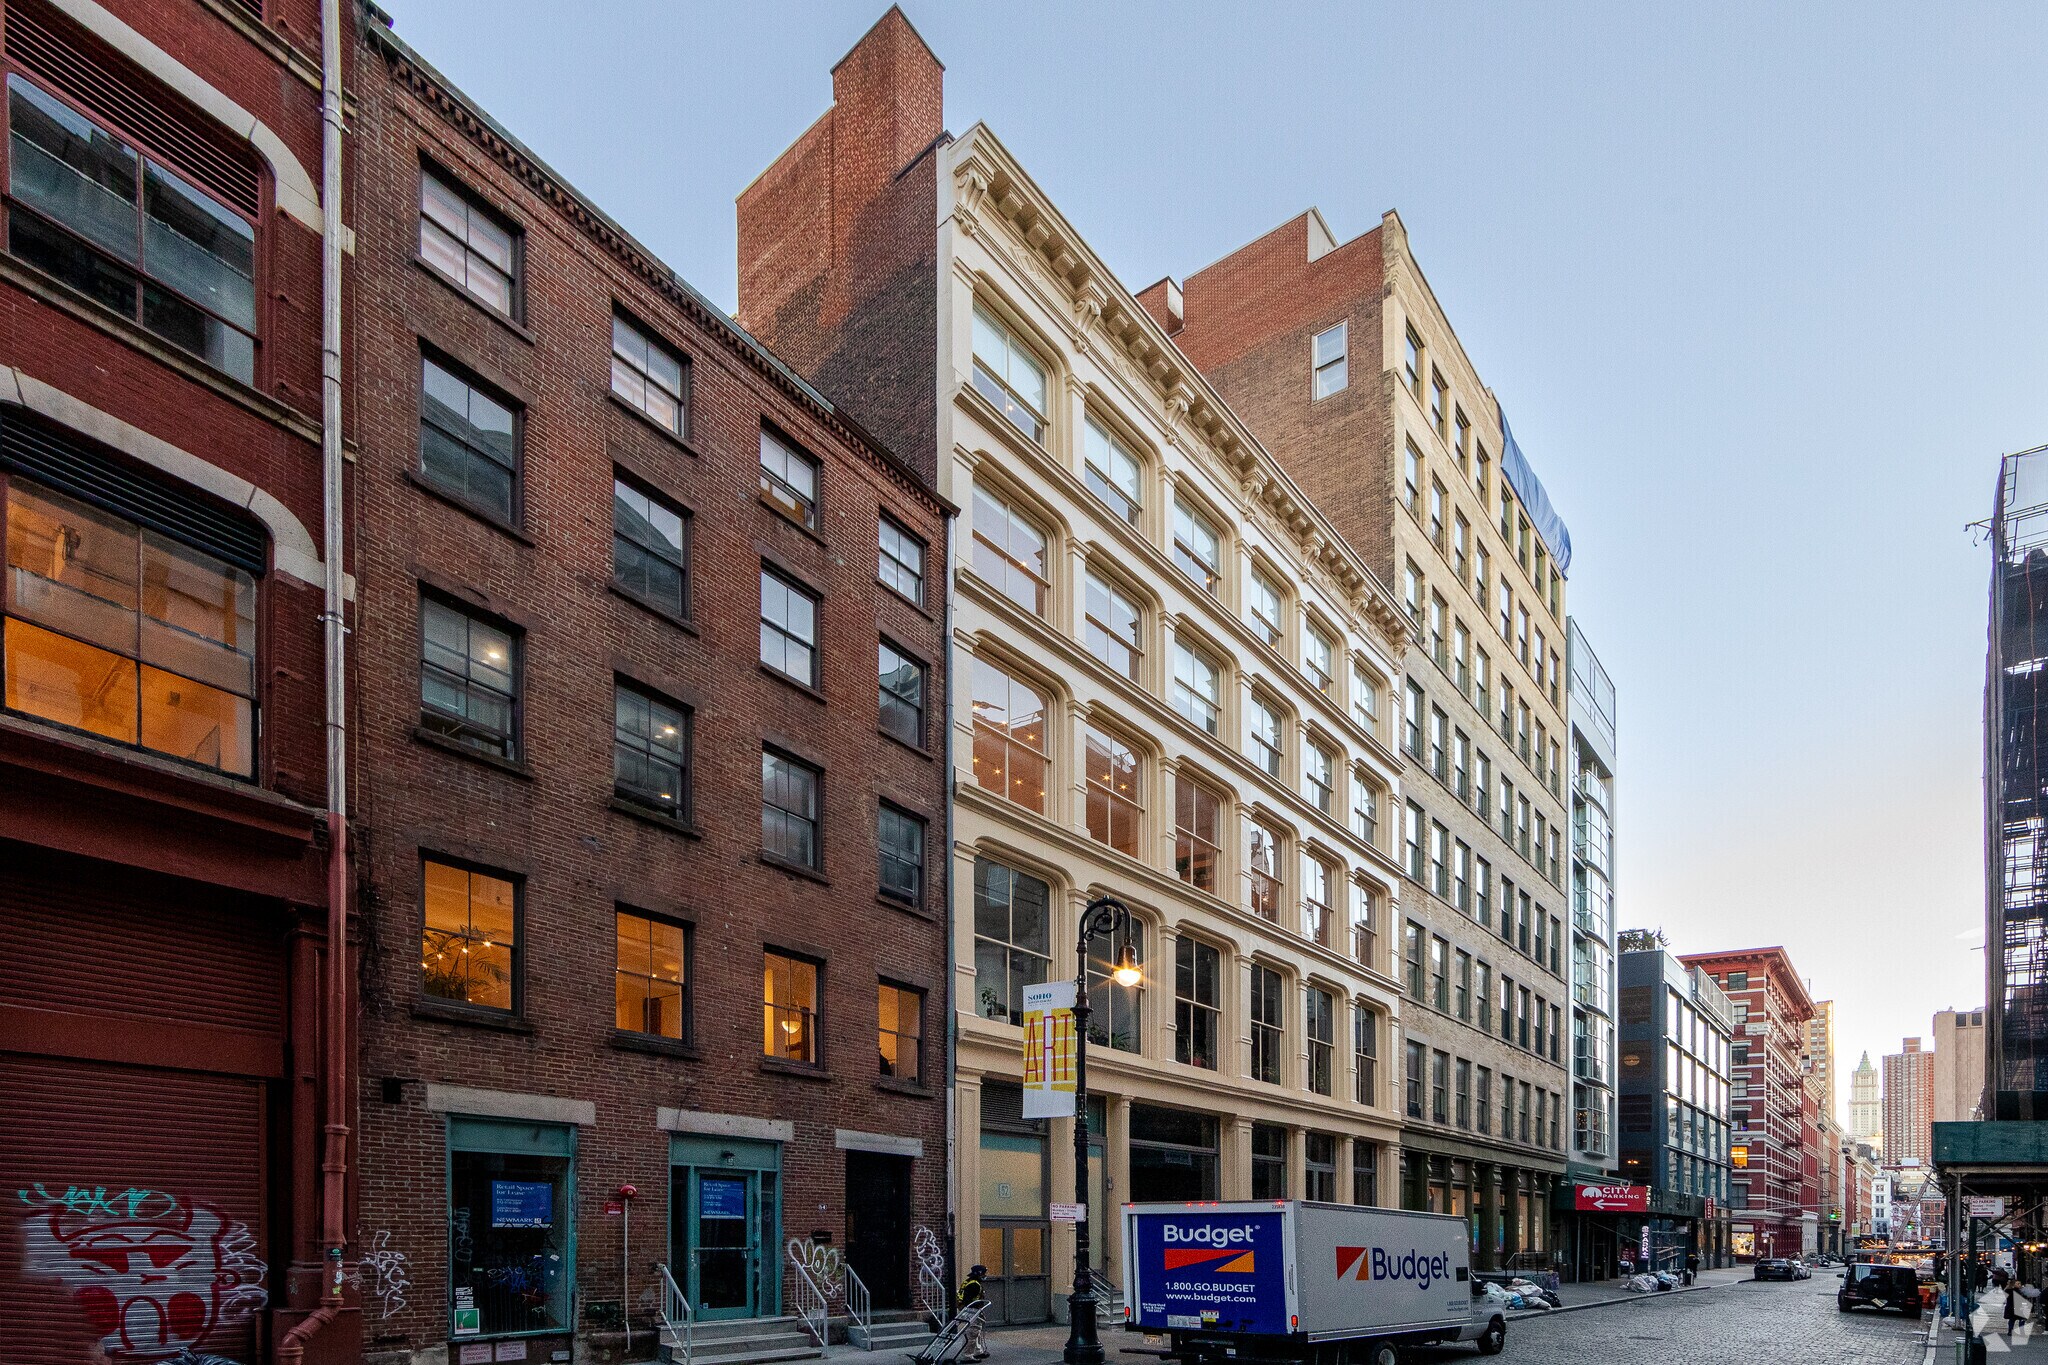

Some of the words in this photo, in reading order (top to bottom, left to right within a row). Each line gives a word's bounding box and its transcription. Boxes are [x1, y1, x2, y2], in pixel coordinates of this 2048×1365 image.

[1028, 993, 1052, 1001] SOHO
[1025, 1013, 1071, 1082] ART
[1163, 1224, 1254, 1248] Budget
[1372, 1247, 1450, 1290] Budget
[1165, 1282, 1255, 1293] 1.800.GO.BUDGET
[1166, 1292, 1256, 1303] www.budget.com
